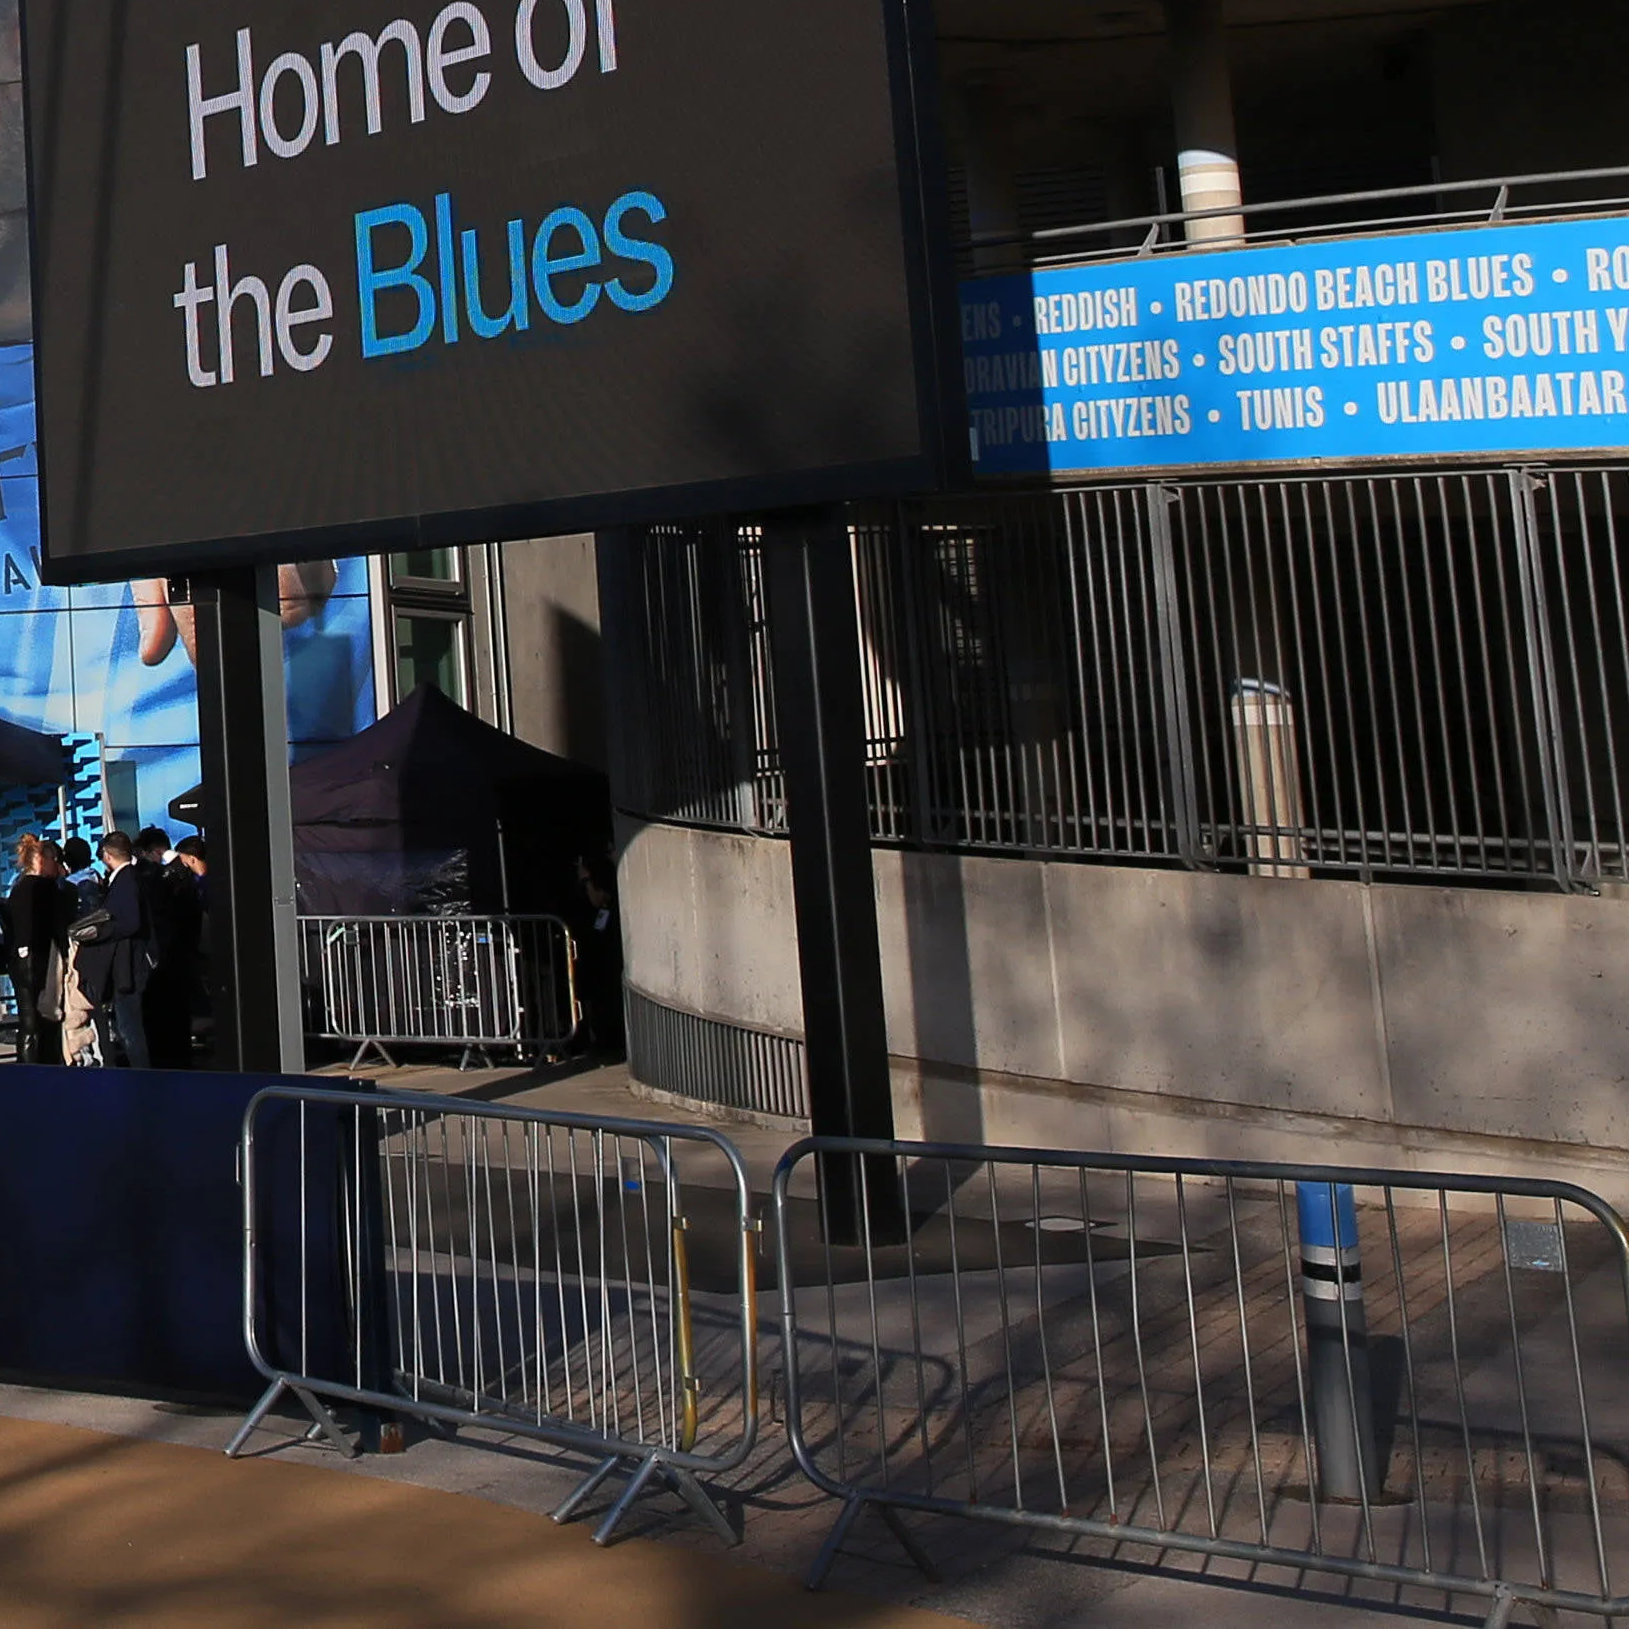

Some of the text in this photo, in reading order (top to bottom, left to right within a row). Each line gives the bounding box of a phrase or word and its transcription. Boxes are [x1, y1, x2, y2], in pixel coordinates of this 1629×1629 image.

[173, 188, 675, 388] the Blues
[1034, 287, 1138, 334] REDDISH
[1175, 272, 1307, 321] REDONDO
[1316, 267, 1417, 311] BEACH
[1426, 253, 1534, 303] BLUES
[1062, 309, 1598, 386] CITYZENS SOUTH STAFFS SOUTH
[1073, 370, 1627, 441] CITYZENS TUNIS ULAANBAATAR
